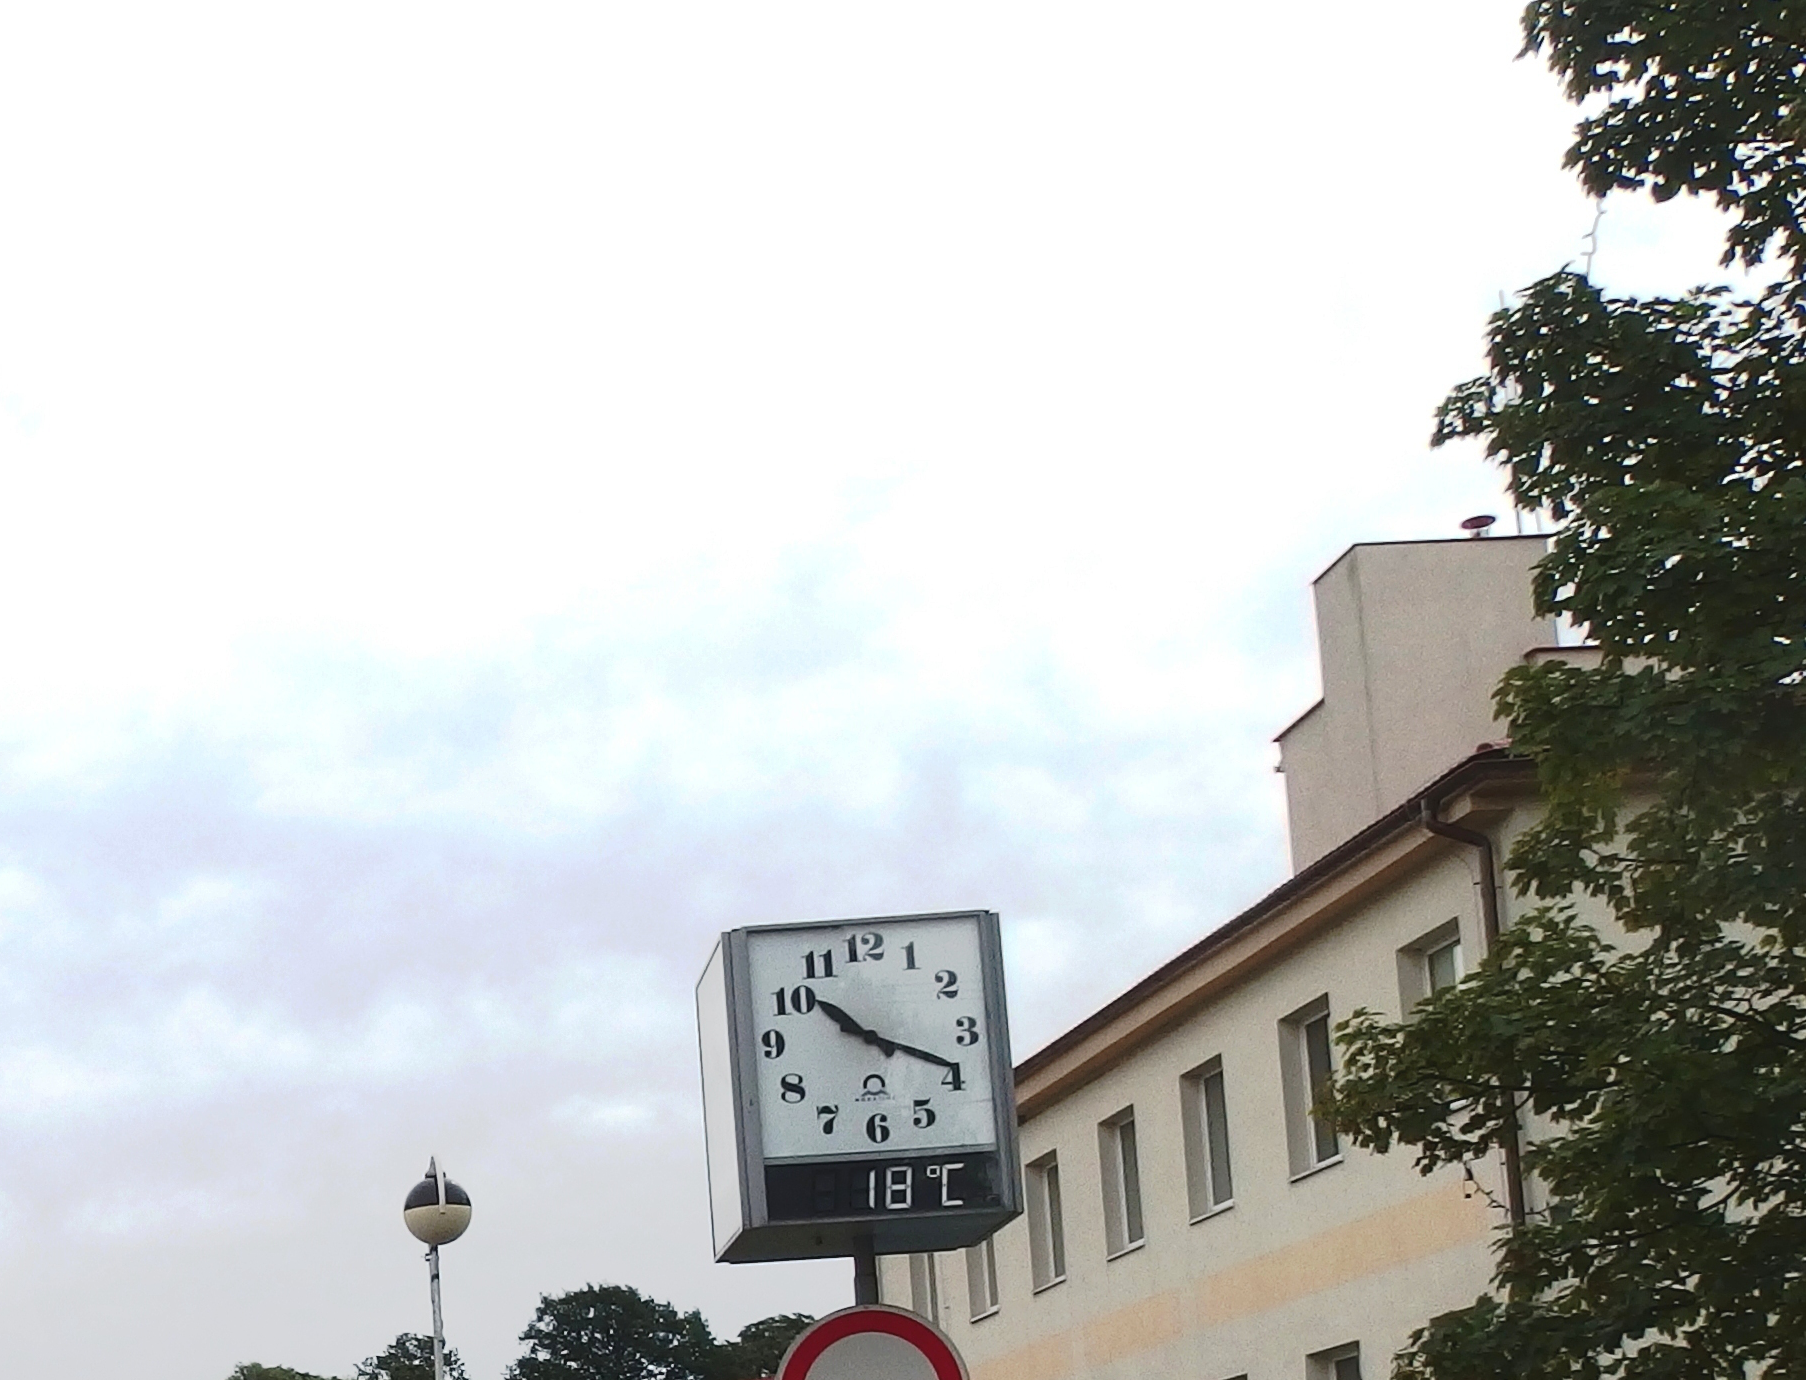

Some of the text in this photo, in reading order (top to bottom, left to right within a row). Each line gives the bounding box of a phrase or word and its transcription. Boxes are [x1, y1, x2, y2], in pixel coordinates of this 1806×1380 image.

[843, 932, 885, 963] 12
[900, 941, 922, 970] 1
[800, 949, 838, 980] 11
[934, 969, 959, 1000] 2
[771, 985, 816, 1016] 10
[761, 1029, 785, 1059] 9
[956, 1016, 979, 1046] 3
[780, 1073, 806, 1103] 8
[941, 1062, 965, 1092] 4
[816, 1104, 839, 1134] 7
[866, 1113, 890, 1143] 6
[912, 1098, 936, 1129] 5
